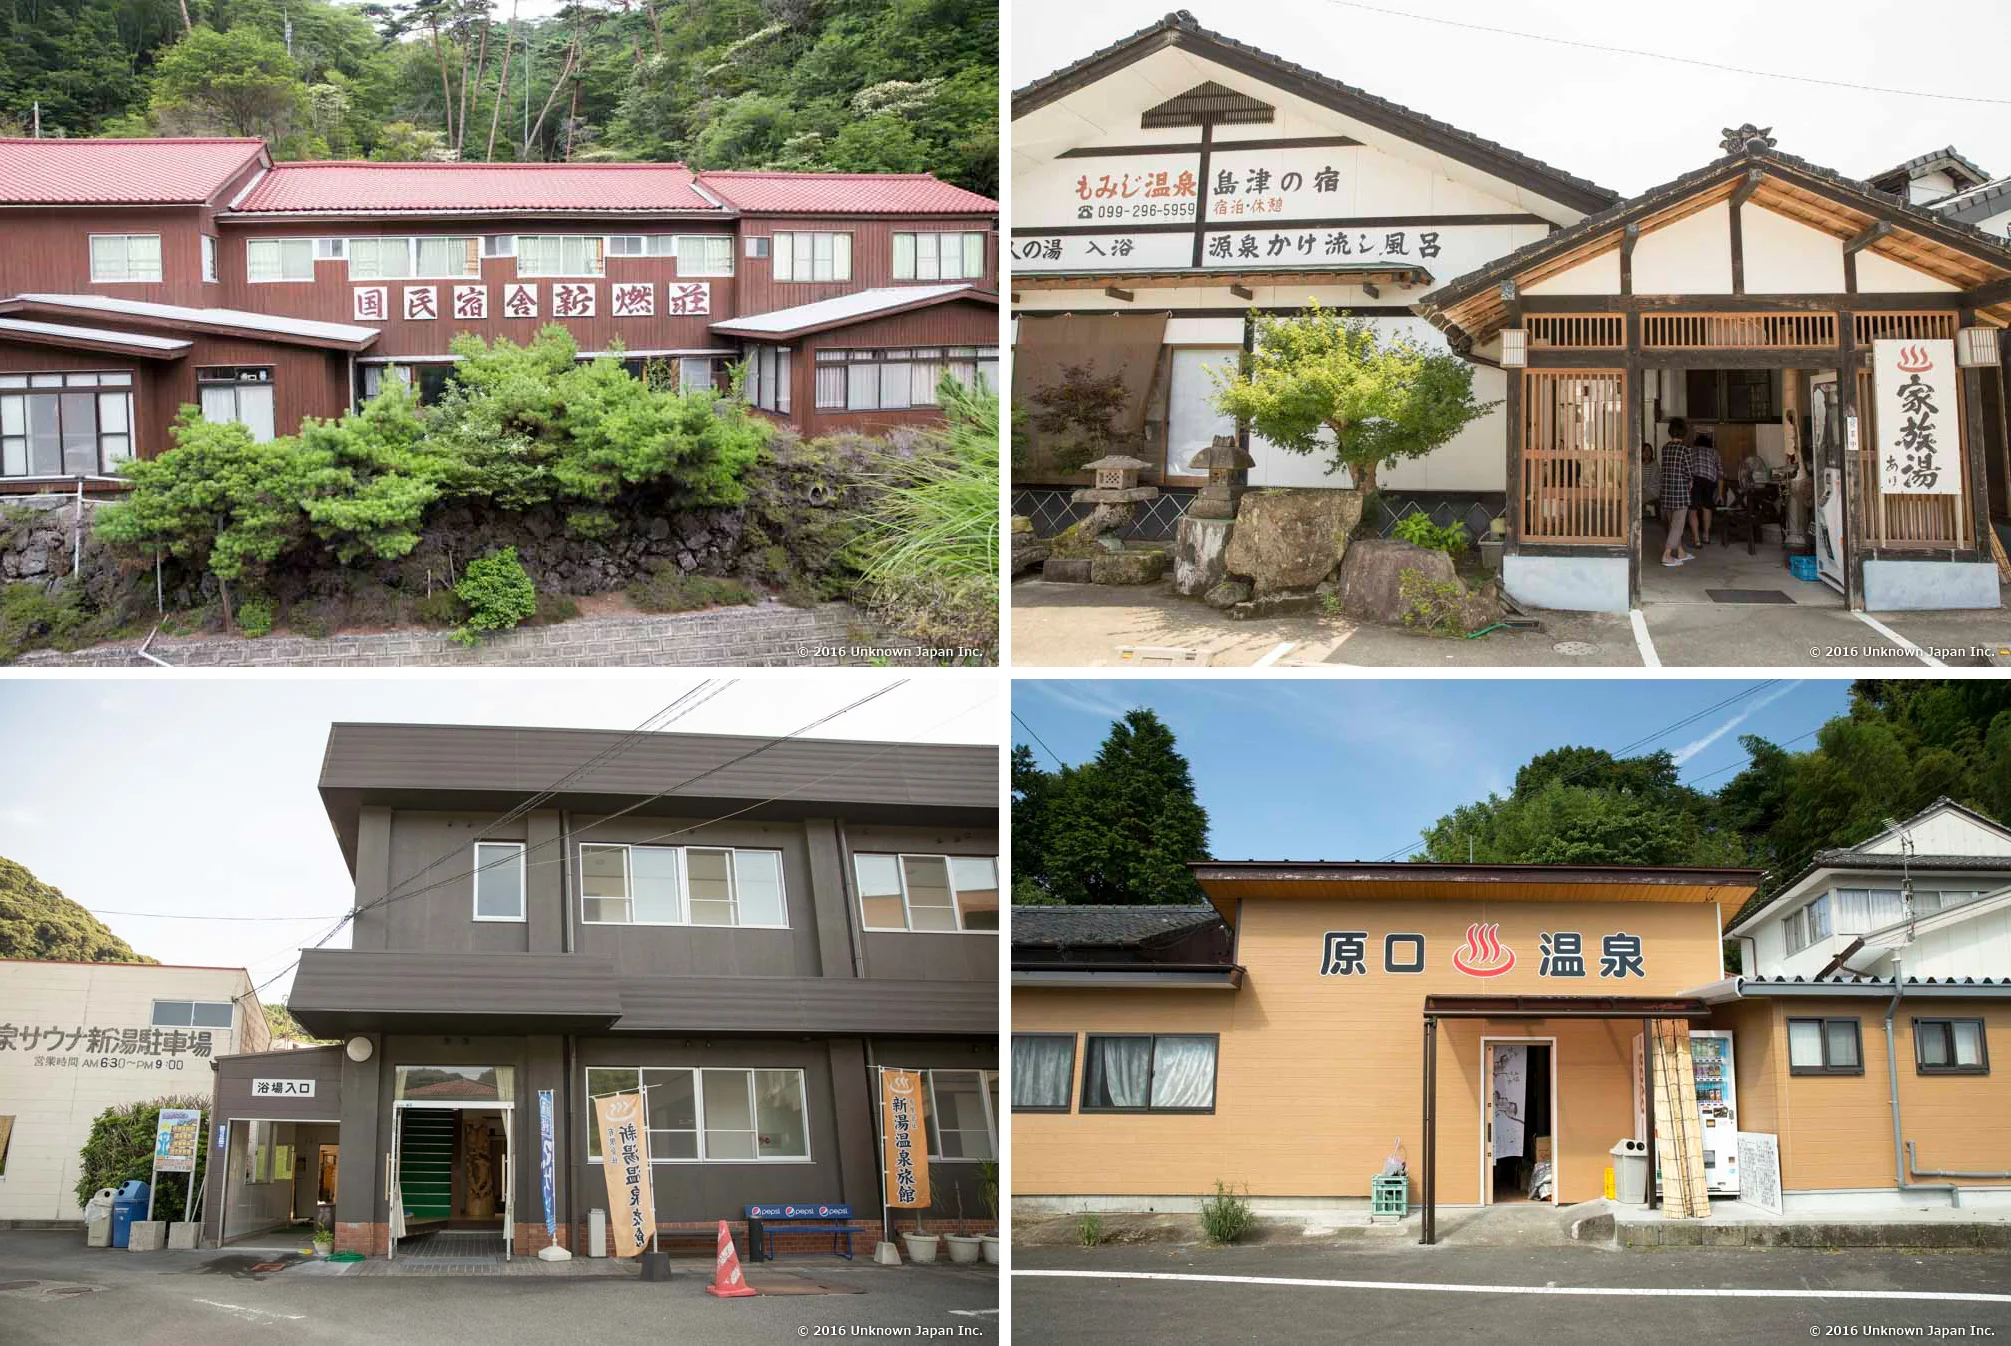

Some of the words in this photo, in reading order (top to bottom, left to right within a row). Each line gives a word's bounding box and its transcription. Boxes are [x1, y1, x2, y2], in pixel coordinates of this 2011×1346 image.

[1075, 170, 1197, 200] もみじ温泉
[1213, 165, 1340, 195] 島津の宿
[1098, 202, 1195, 218] 099-296-5959
[1085, 239, 1134, 257] 入浴
[1208, 231, 1442, 259] 源泉かけ流し風呂
[1894, 374, 1942, 490] 家族湯
[1885, 455, 1898, 486] あり
[1320, 931, 1425, 975] 原口
[1538, 931, 1645, 978] 温泉
[257, 1081, 310, 1094] 浴場入口
[892, 1096, 916, 1203] 新湯温泉旅館
